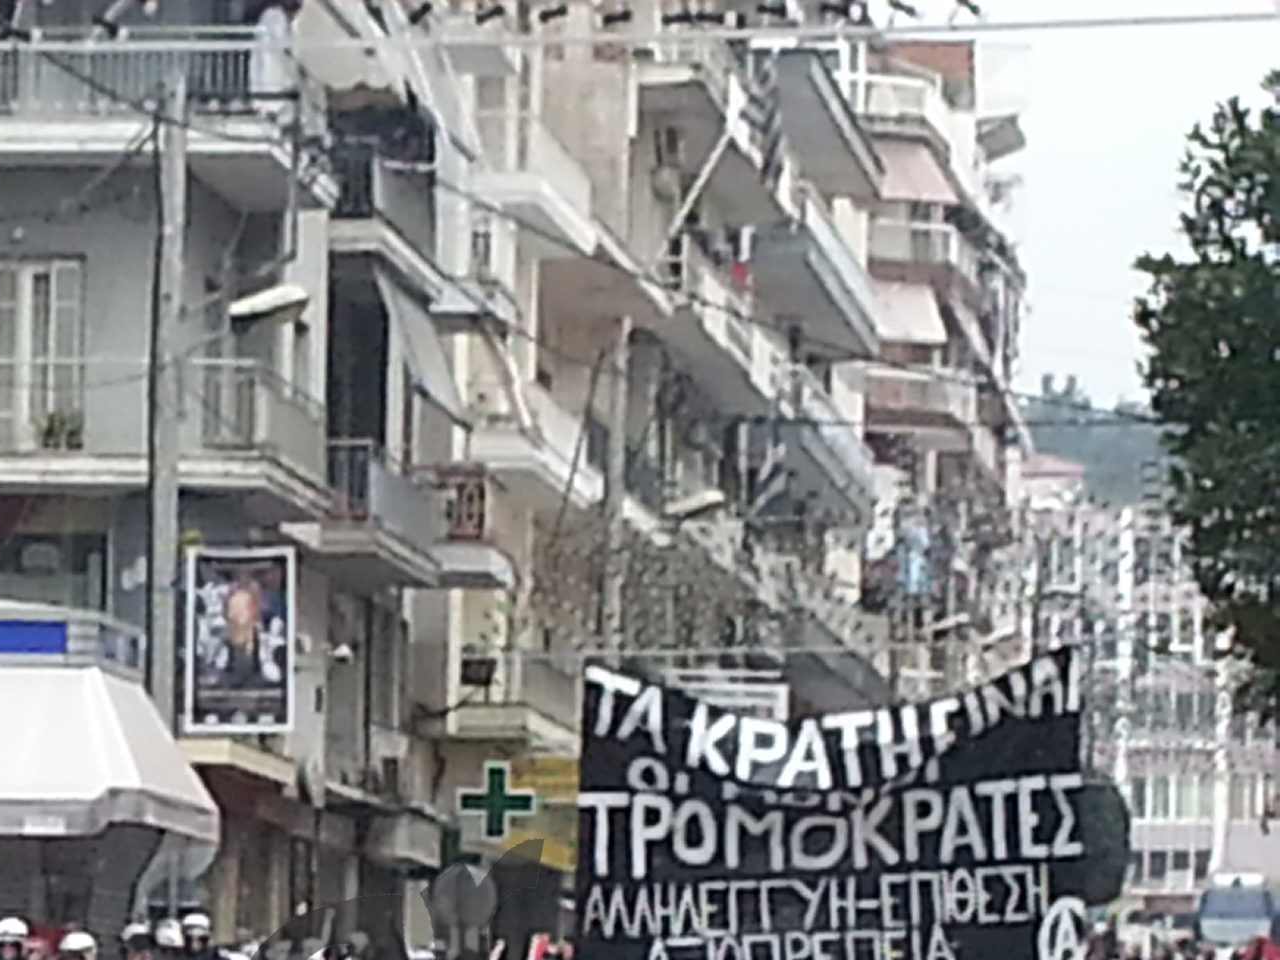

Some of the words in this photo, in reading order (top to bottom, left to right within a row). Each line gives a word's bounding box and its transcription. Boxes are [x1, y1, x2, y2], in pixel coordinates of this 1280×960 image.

[585, 664, 667, 754] ΤΑ
[685, 701, 923, 792] ΚΡΑΤΗ
[578, 773, 1084, 878] ΤΡΟΜΟΚΡΑΤΕΣ
